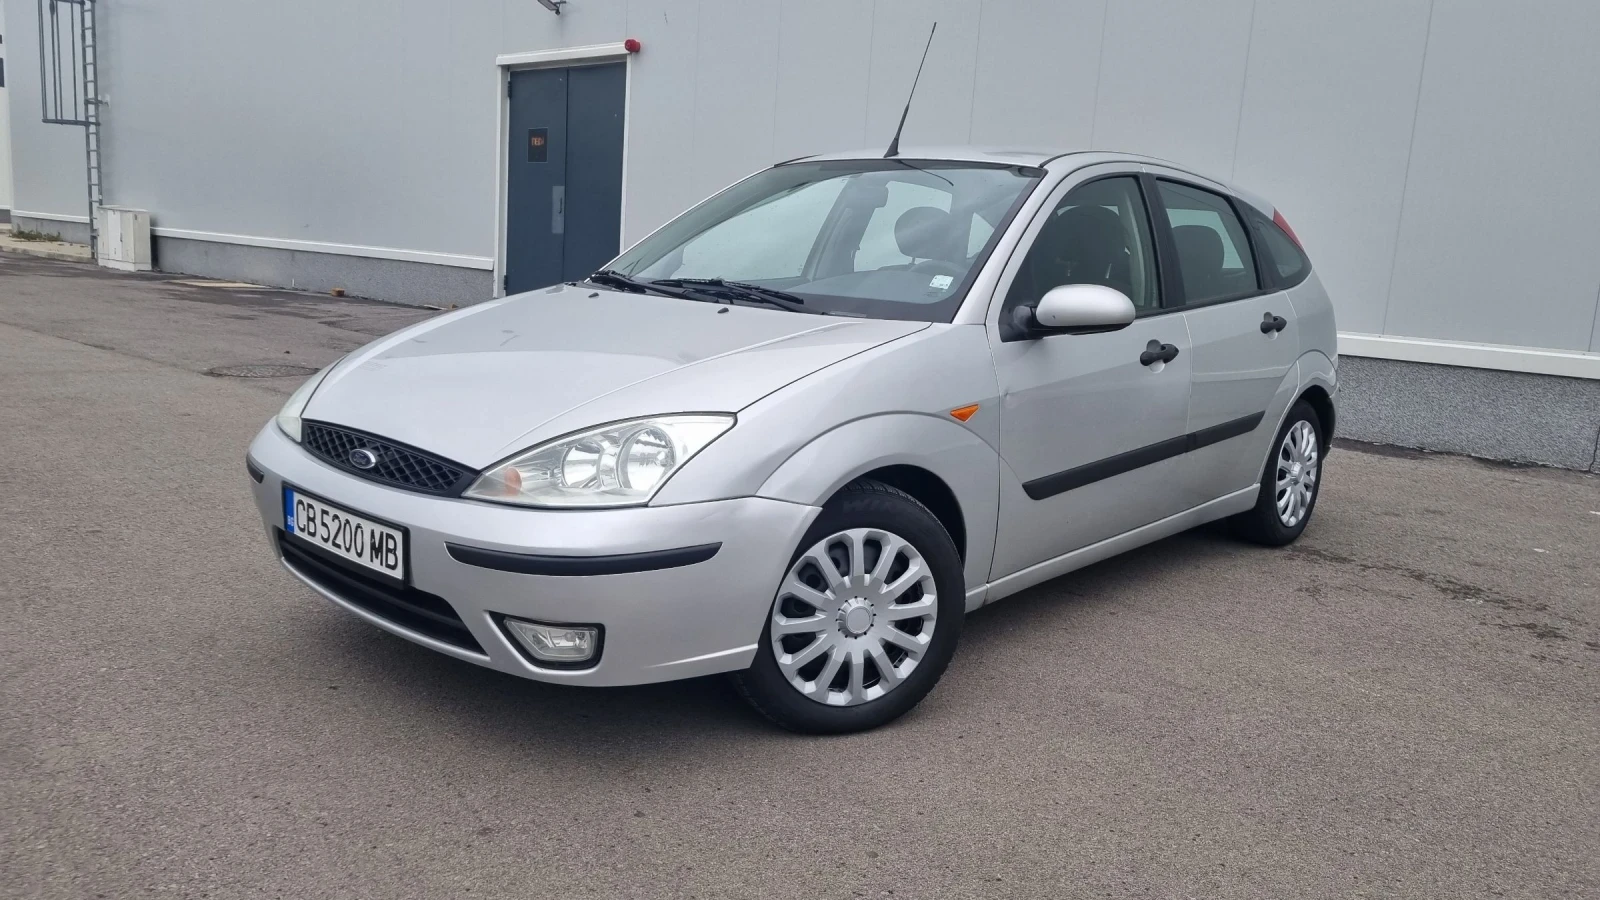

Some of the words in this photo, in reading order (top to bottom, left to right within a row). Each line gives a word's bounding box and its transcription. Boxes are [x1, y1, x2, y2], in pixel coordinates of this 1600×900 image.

[296, 499, 317, 538] CB
[320, 508, 364, 558] 5200
[369, 528, 398, 571] MB
